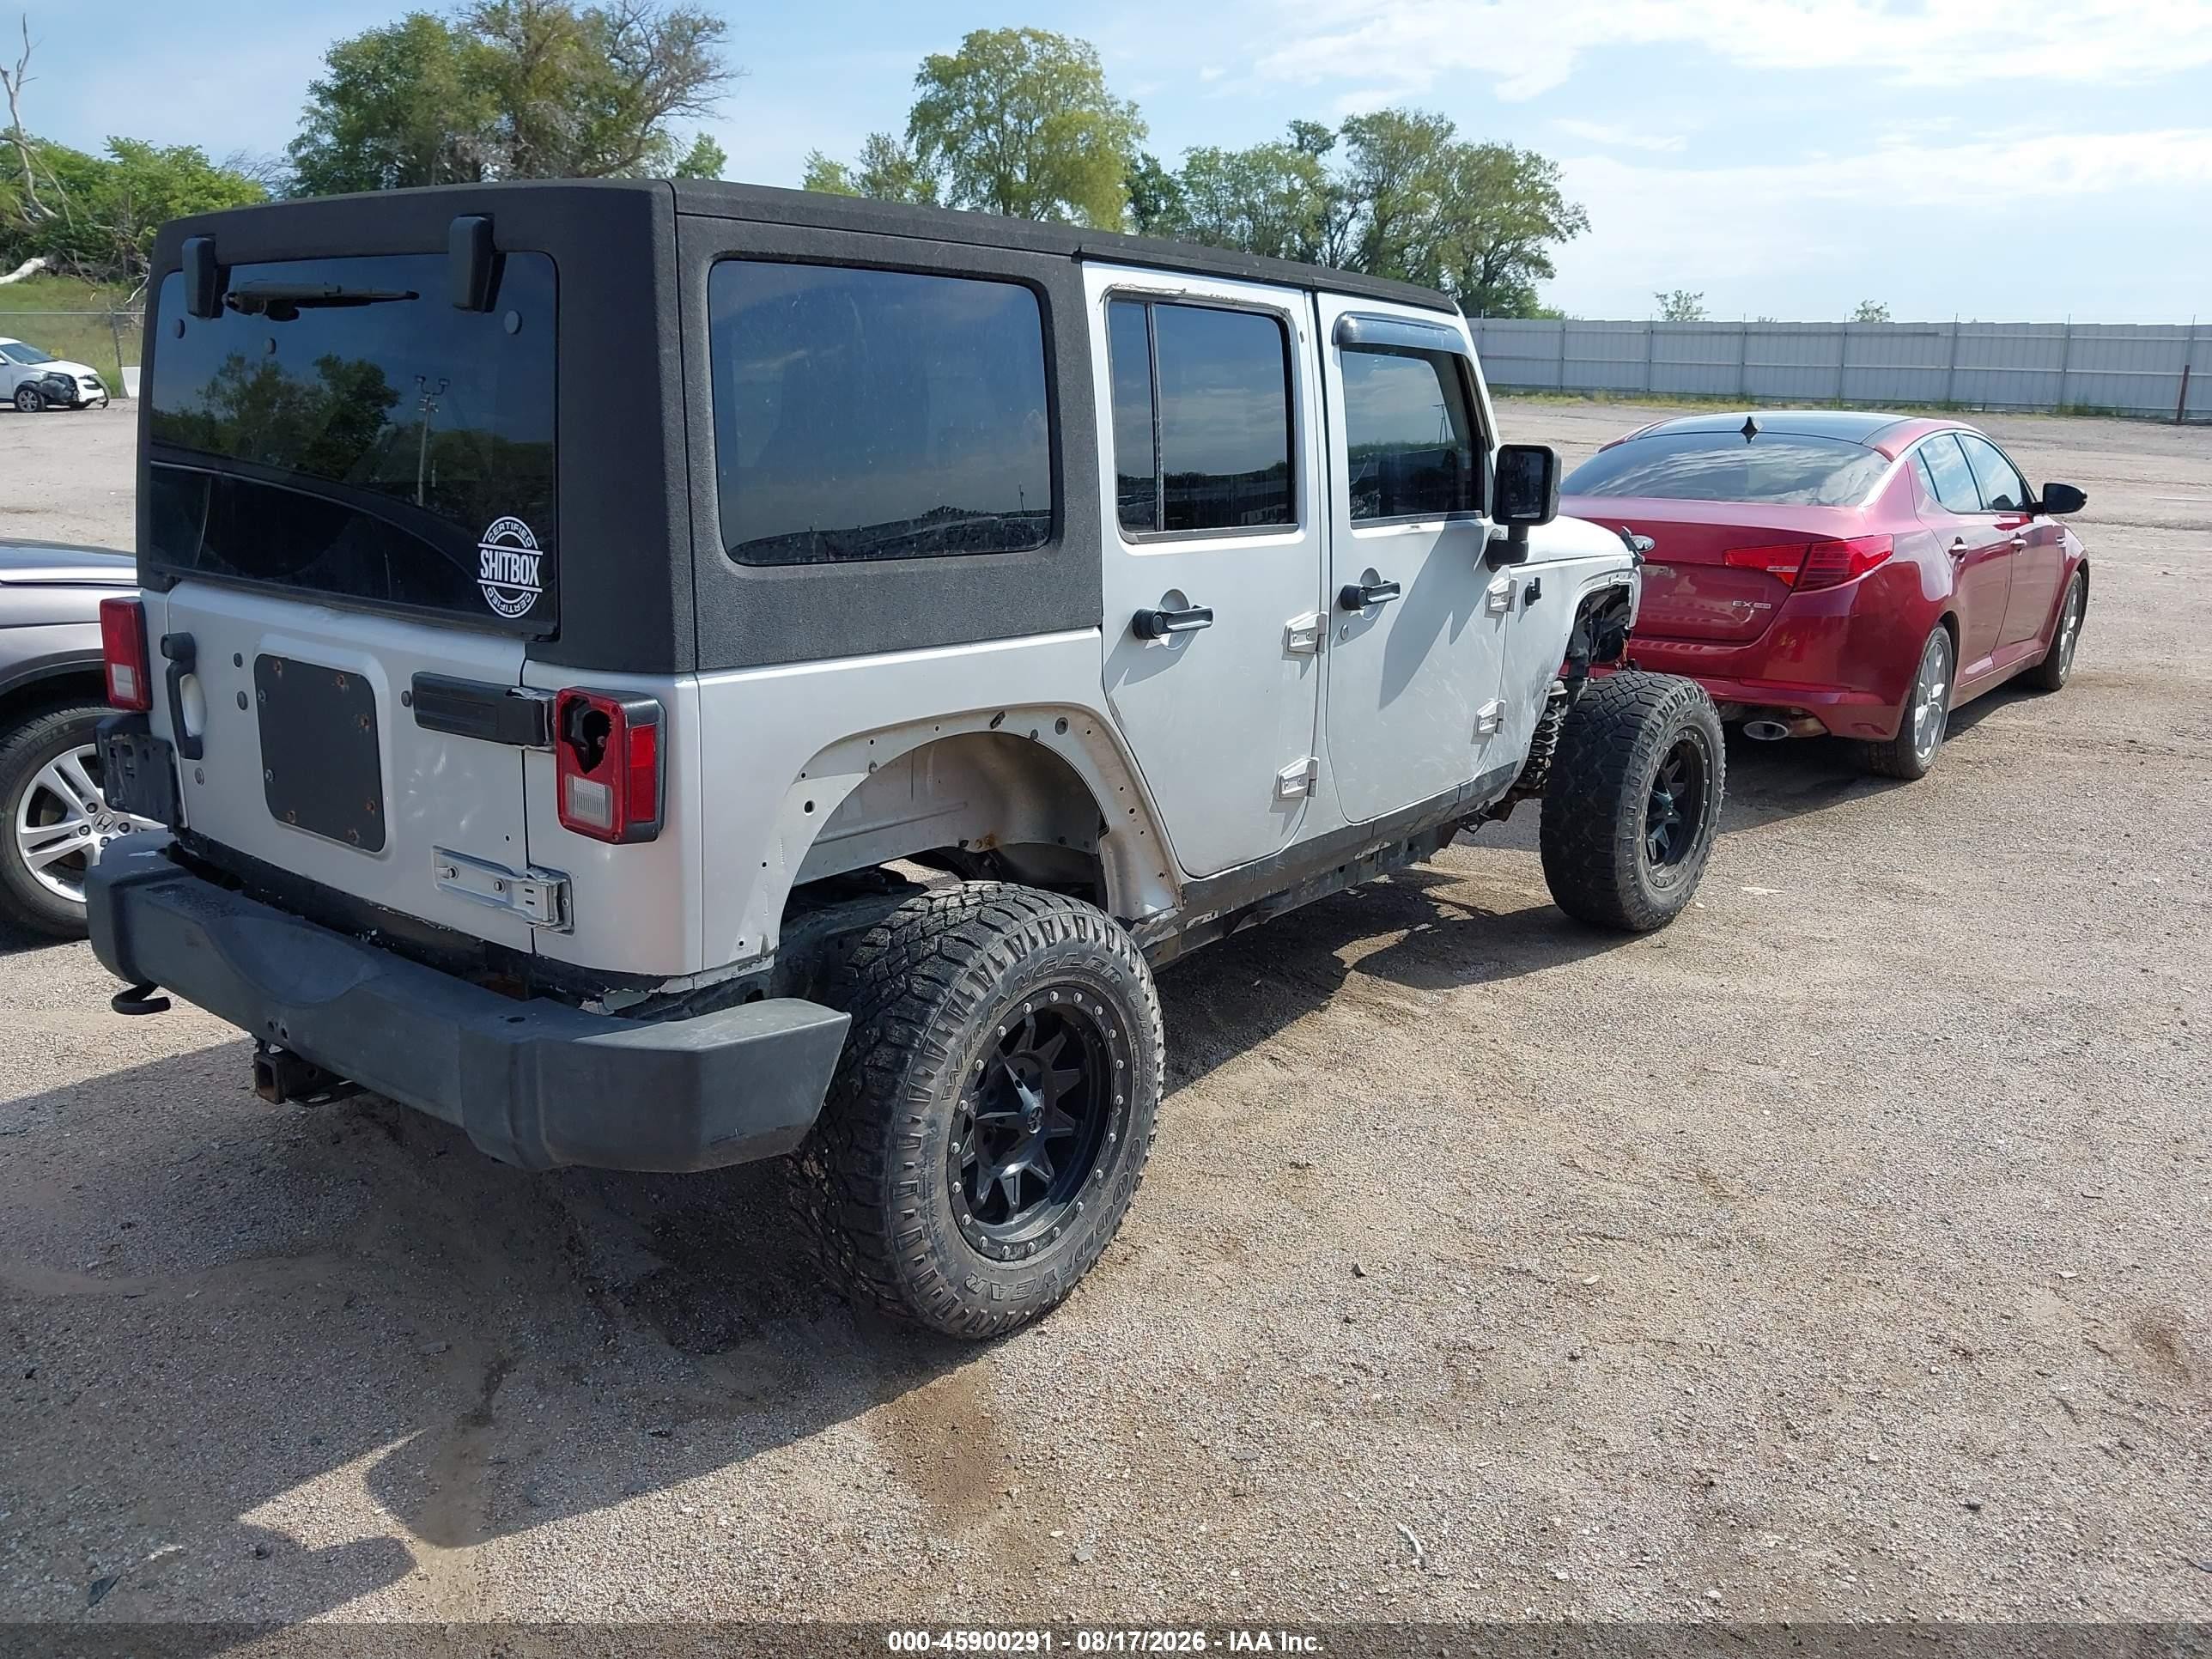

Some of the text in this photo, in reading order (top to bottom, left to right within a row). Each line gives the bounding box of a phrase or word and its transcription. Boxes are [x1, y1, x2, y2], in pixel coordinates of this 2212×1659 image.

[487, 521, 533, 548] CERTIFIED
[480, 549, 540, 586] SHITBOX
[487, 586, 532, 614] CERTIFIED
[941, 952, 1125, 1101] WRANGLER
[963, 1138, 1141, 1302] GOODYEAR
